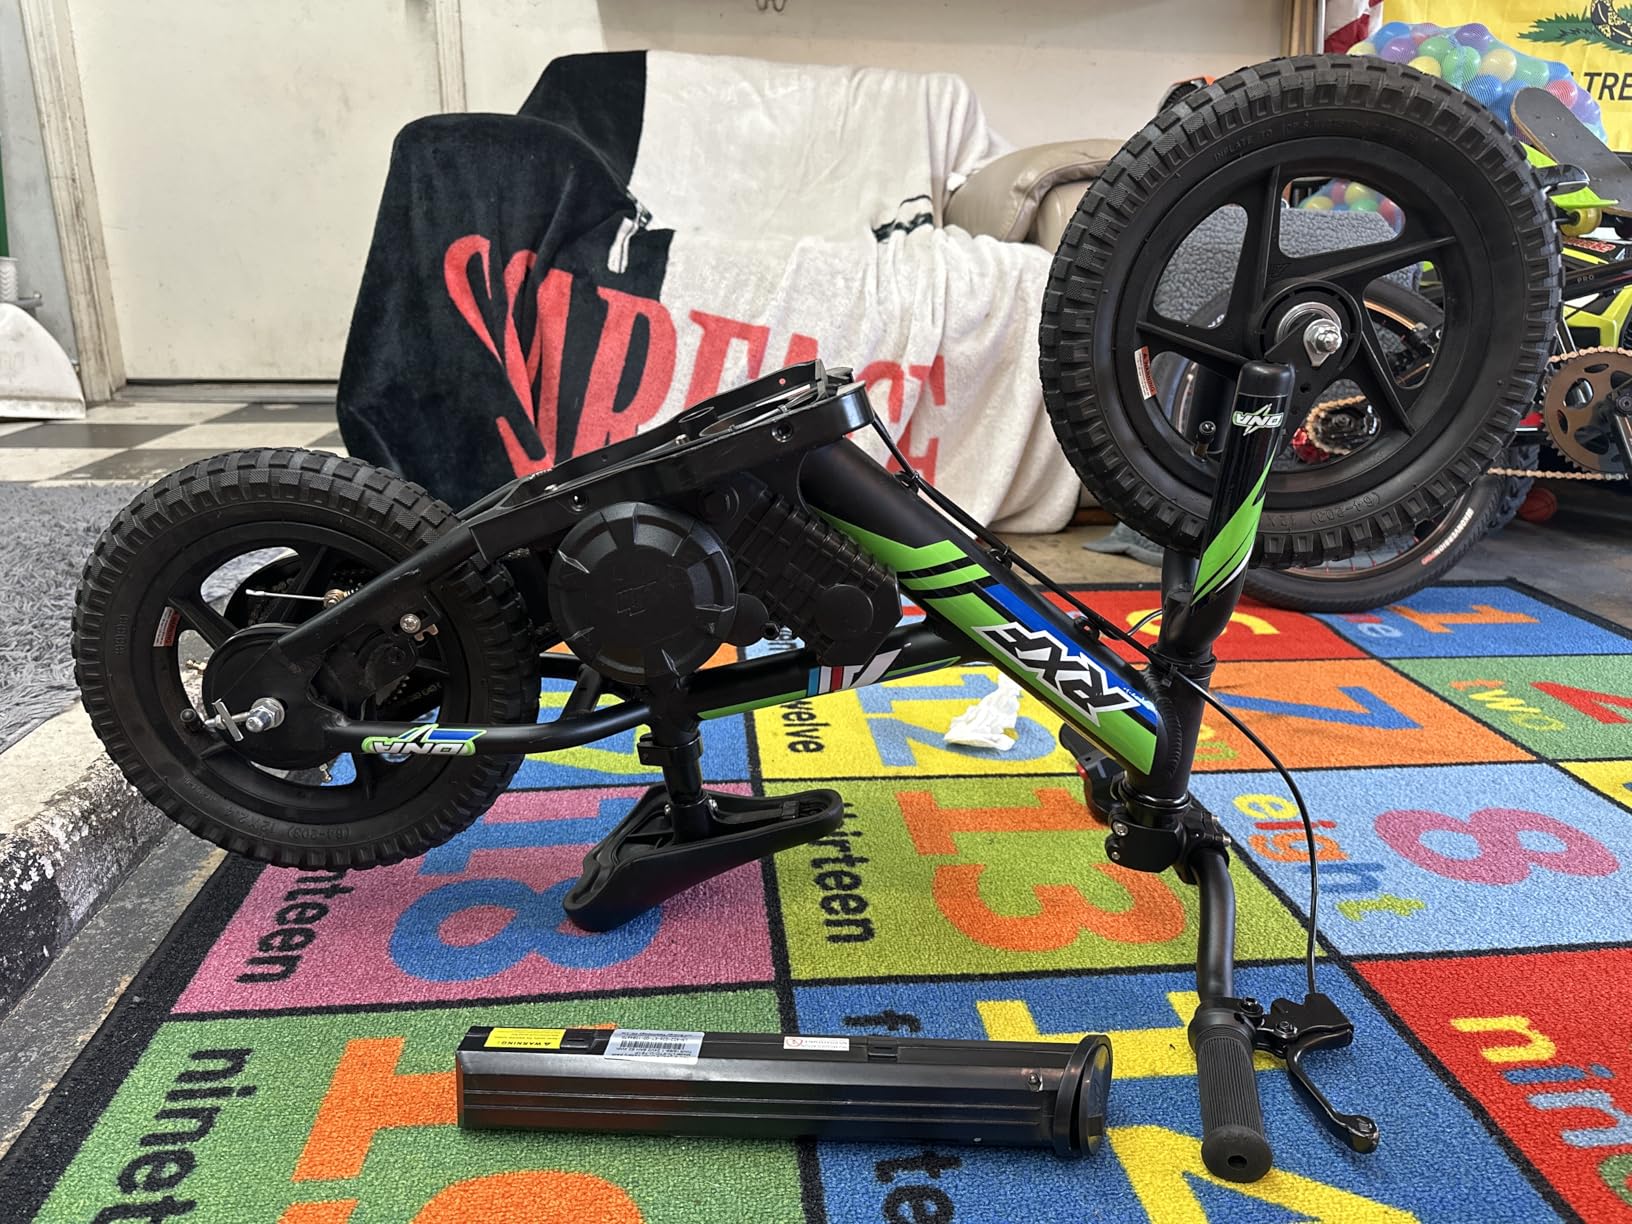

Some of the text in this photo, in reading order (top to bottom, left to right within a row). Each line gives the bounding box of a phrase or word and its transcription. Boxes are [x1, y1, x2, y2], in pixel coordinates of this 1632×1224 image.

[1233, 408, 1284, 431] DNA
[974, 624, 1137, 724] RXF
[1213, 685, 1423, 731] 7
[1451, 679, 1566, 732] two
[389, 797, 664, 983] 18
[895, 788, 1187, 953] 13
[1232, 793, 1426, 922] eight
[1374, 807, 1621, 885] 8
